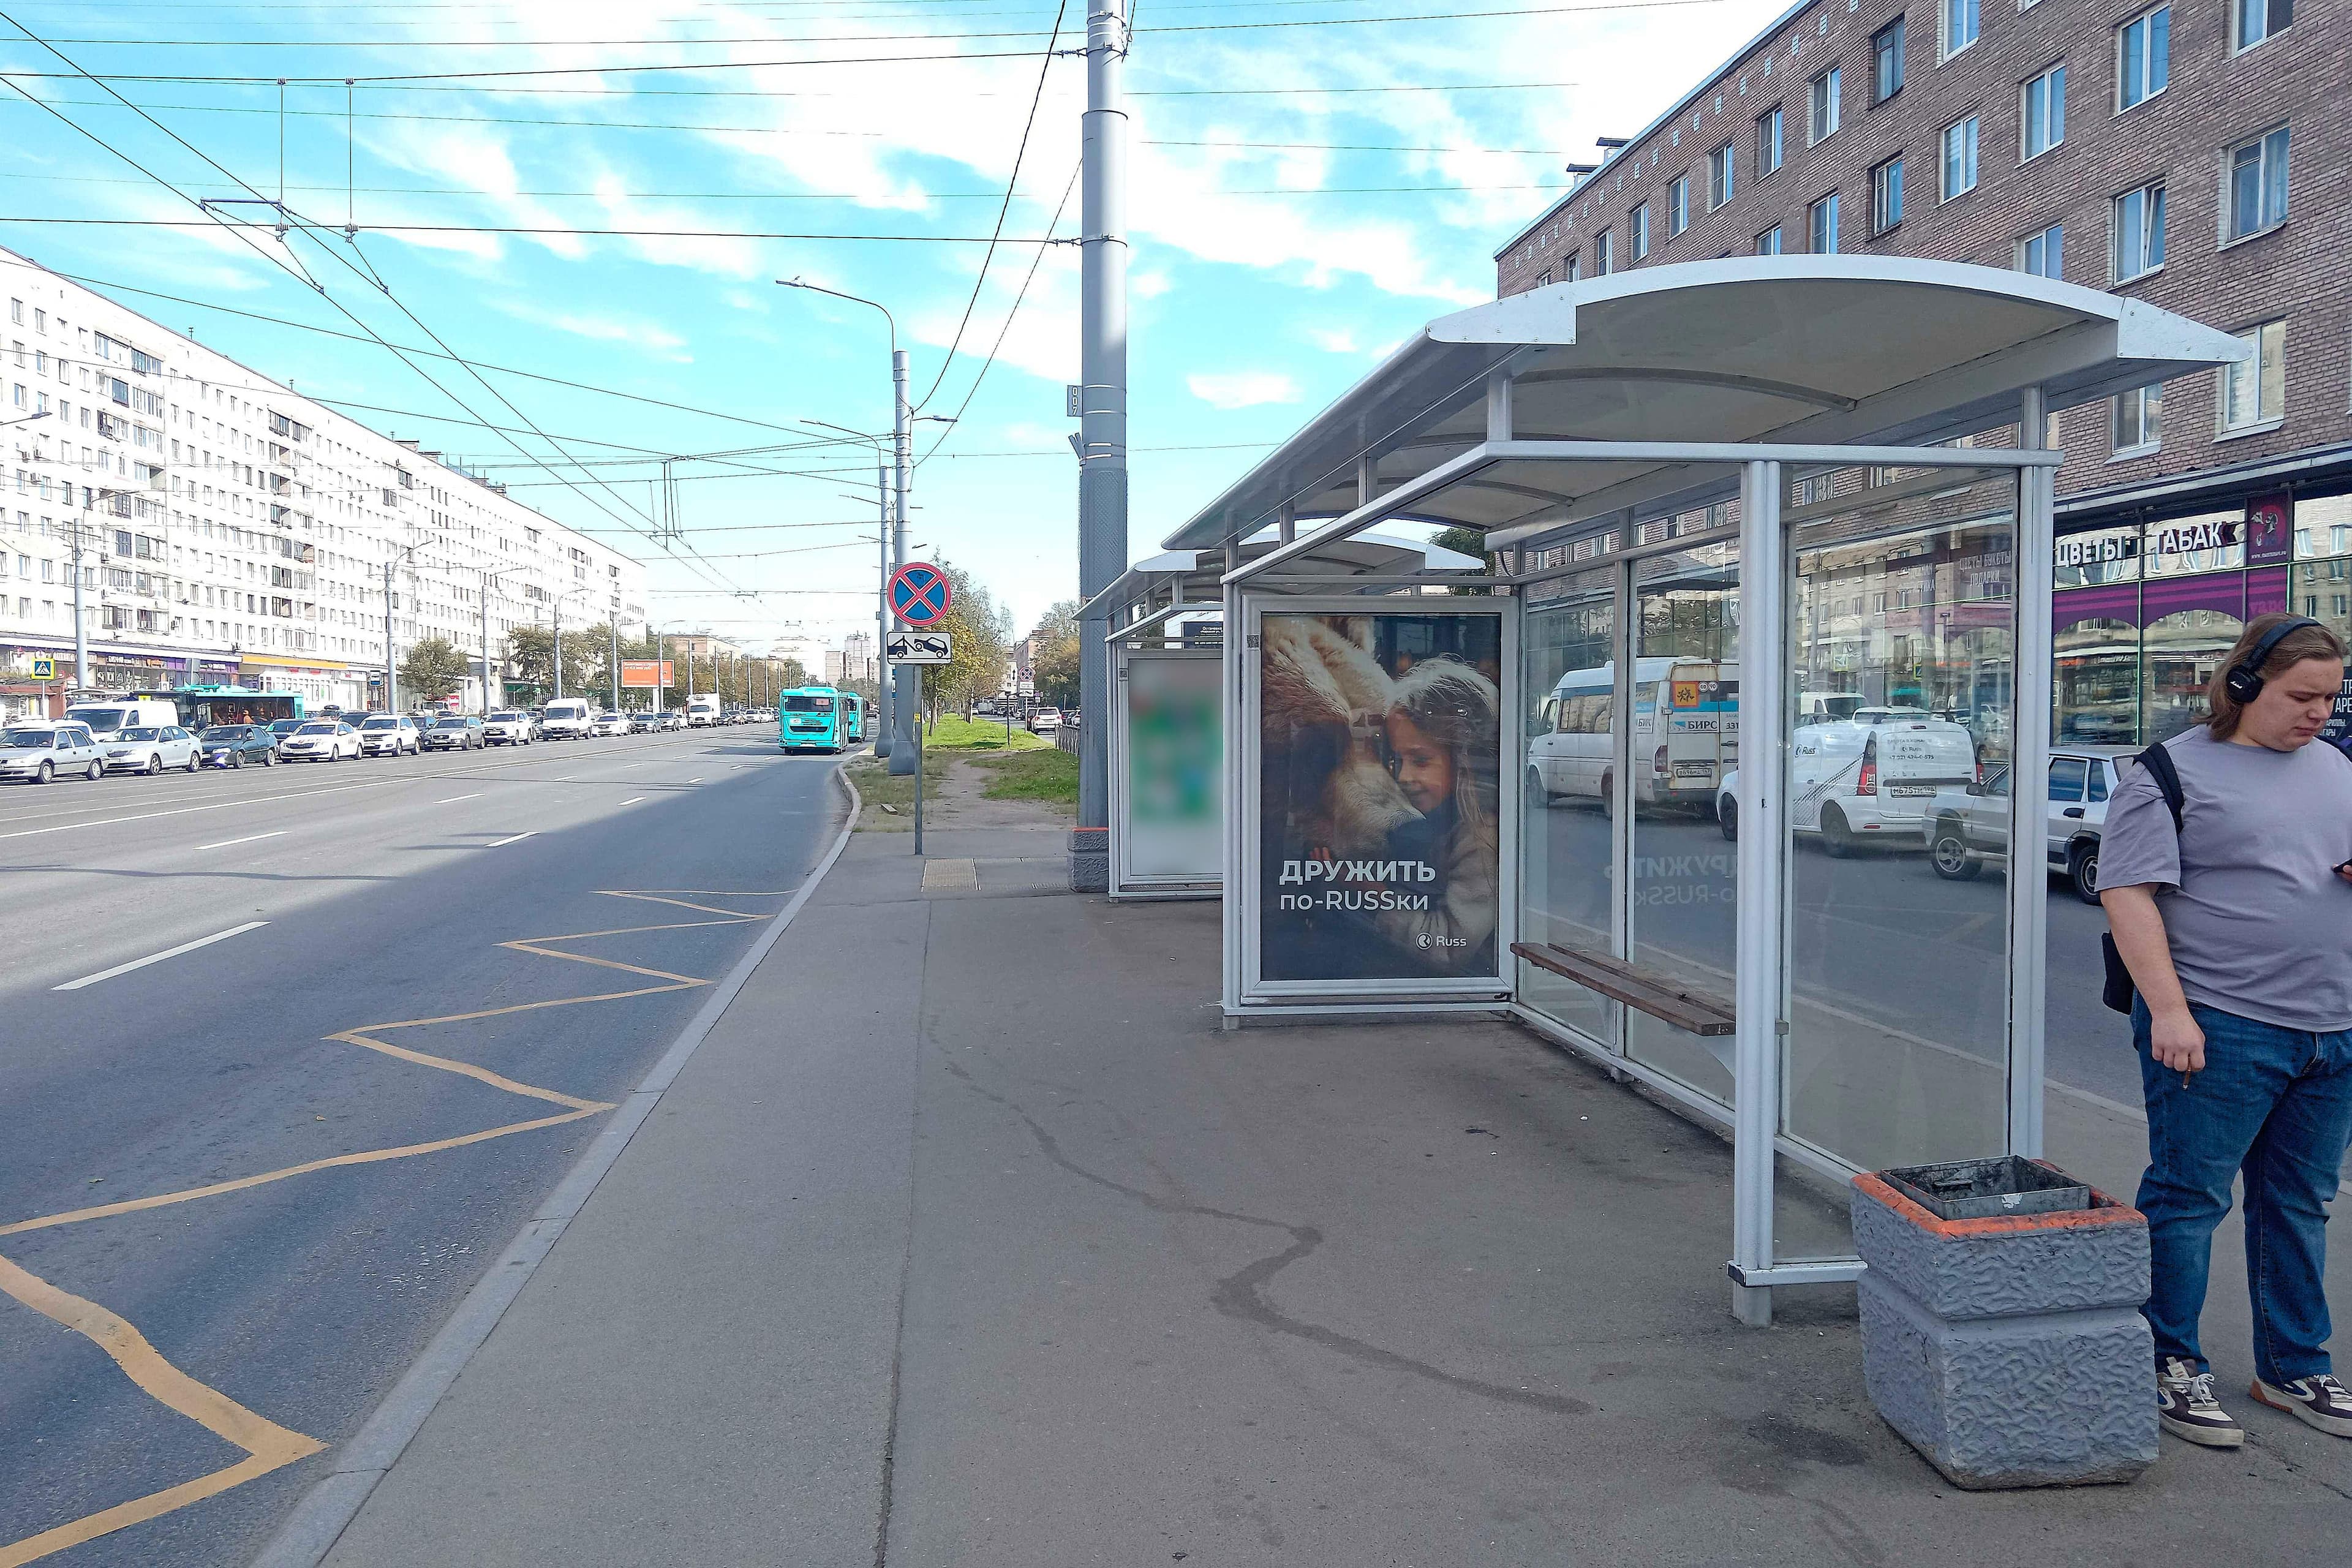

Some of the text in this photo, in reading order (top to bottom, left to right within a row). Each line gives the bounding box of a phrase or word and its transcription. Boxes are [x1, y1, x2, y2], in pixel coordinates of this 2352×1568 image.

[2057, 522, 2223, 567] ЦВЕТЫ ТАБАК
[1960, 550, 2011, 572] ЦВЕТЫ БУКЕТЫ
[1970, 570, 2000, 587] ПОДАРКИ
[1687, 720, 1717, 729] БИРС
[1279, 860, 1436, 886] ДРУЖИТЬ
[1280, 890, 1429, 911] по-RUSSки
[1436, 935, 1467, 947] Russ
